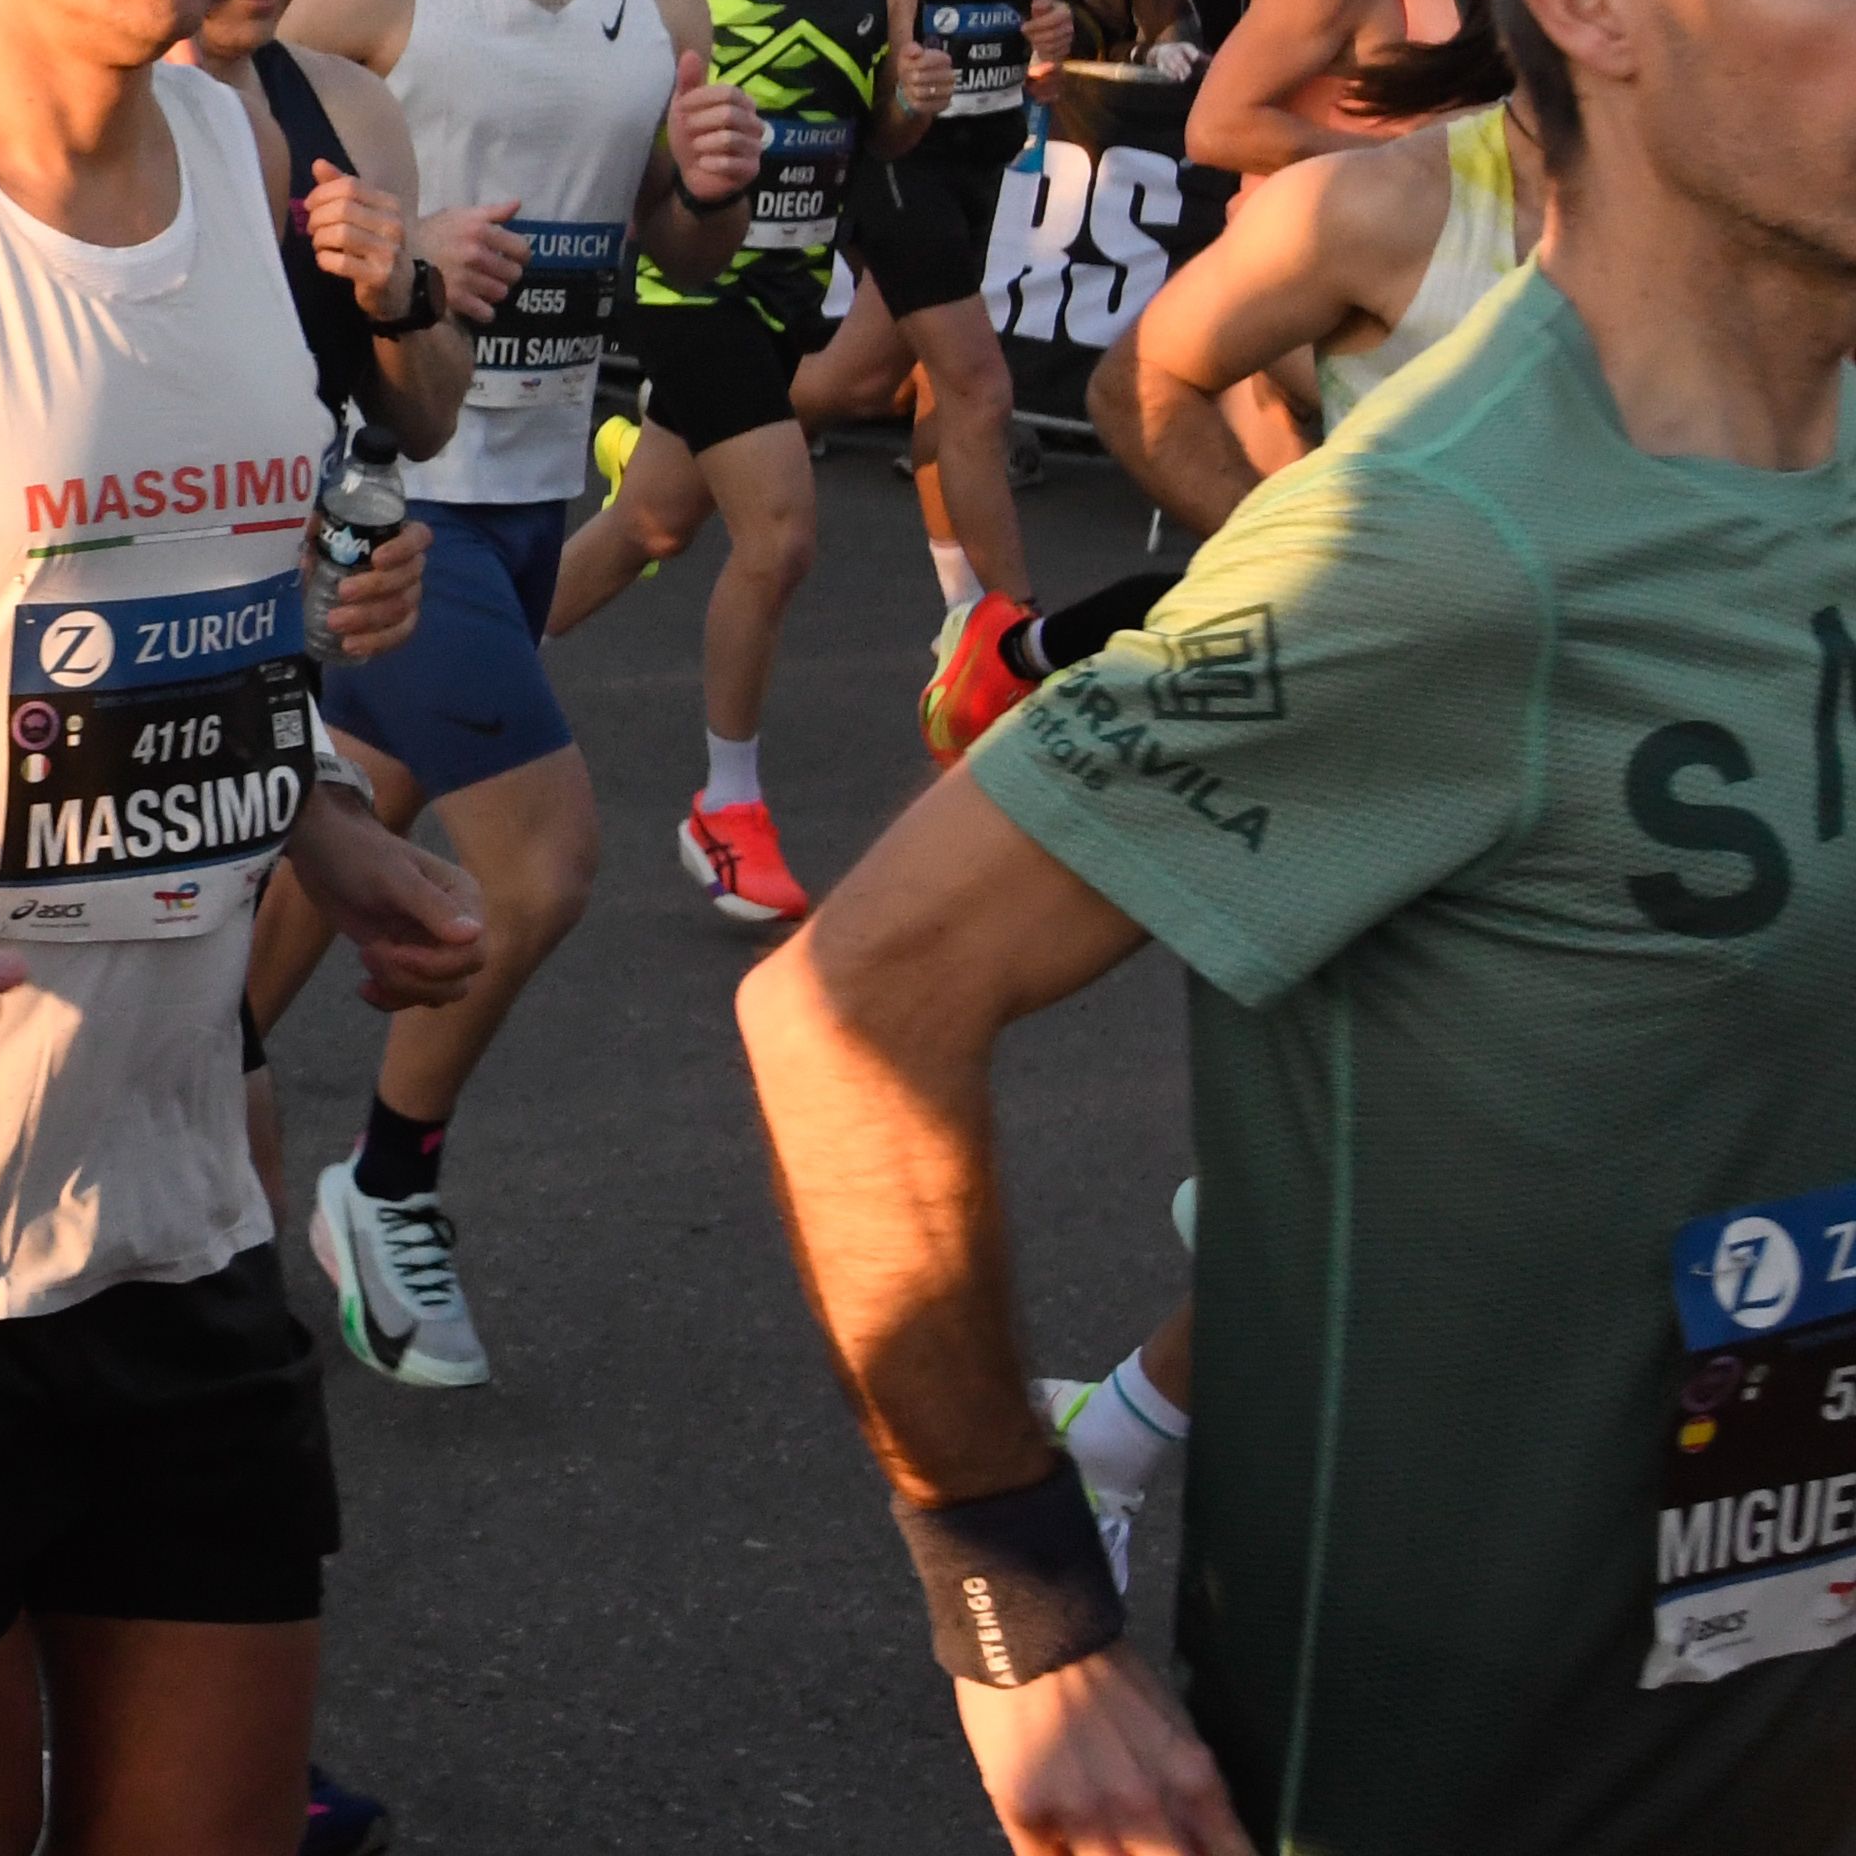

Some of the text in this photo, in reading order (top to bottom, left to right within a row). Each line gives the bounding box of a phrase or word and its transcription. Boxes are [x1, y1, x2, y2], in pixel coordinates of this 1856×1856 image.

[783, 128, 847, 146] ZURICH
[756, 190, 824, 218] DIEGO
[516, 288, 567, 314] 4555
[25, 455, 312, 532] MASSIMO
[135, 599, 277, 664] ZURICH
[131, 714, 221, 764] 4116
[25, 765, 300, 869] MASSIMO
[963, 1577, 1019, 1685] ARTENGO
